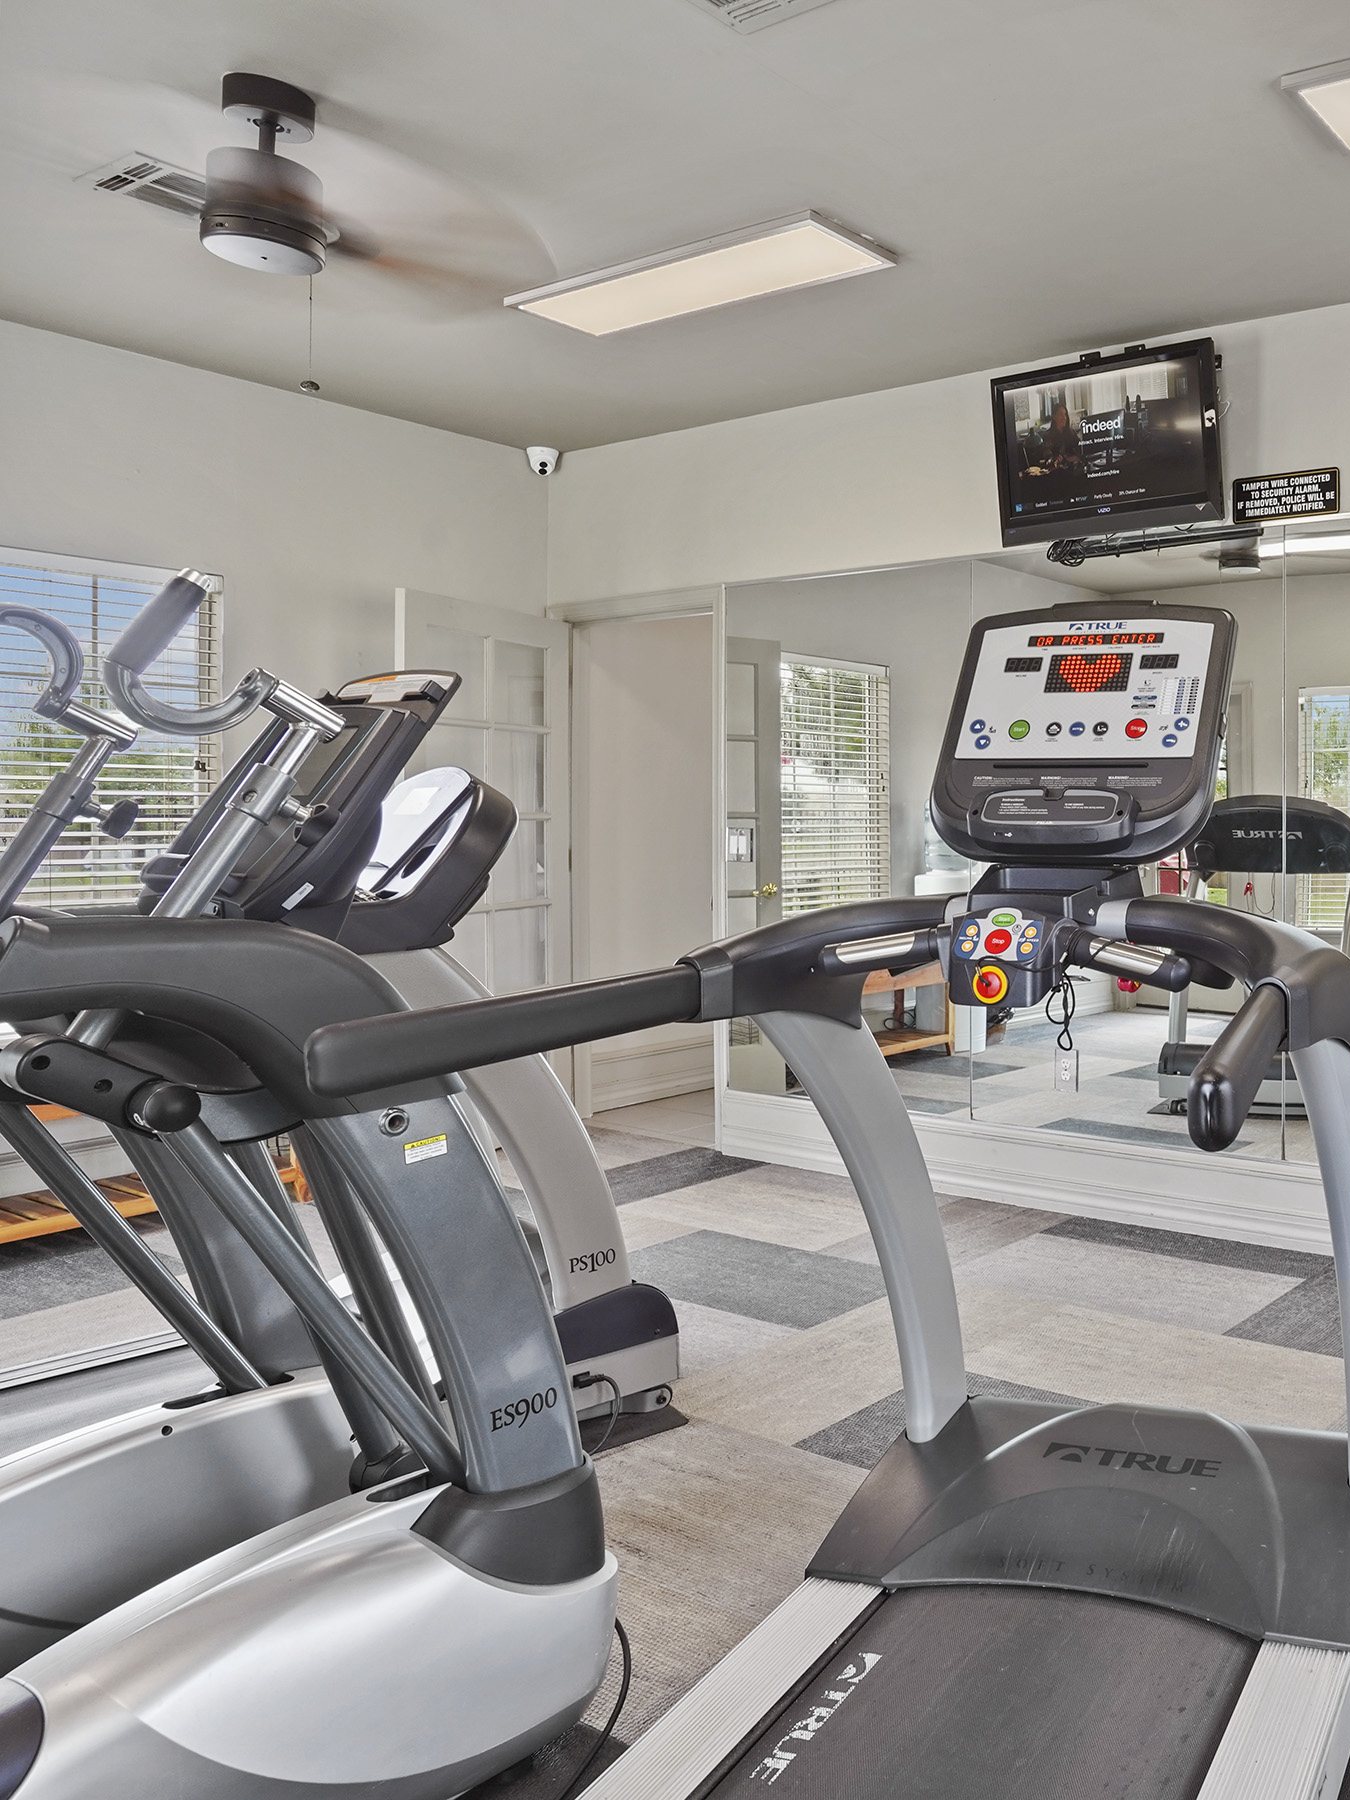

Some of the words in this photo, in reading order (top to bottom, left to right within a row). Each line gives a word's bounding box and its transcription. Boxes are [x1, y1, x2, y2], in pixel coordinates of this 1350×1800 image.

[1081, 416, 1120, 434] indeed
[1242, 481, 1269, 491] TAMPER
[1271, 478, 1288, 488] WIRE
[1290, 474, 1331, 486] CONNECTED
[1251, 491, 1260, 499] TO
[1261, 487, 1294, 498] SECURITY
[1295, 484, 1321, 494] ALARM.
[1237, 502, 1244, 510] IF
[1245, 498, 1280, 509] REMOVED,
[1281, 495, 1306, 504] POLICE
[1307, 493, 1324, 502] WILL
[1325, 491, 1335, 500] BE
[1245, 505, 1292, 517] IMMEDIATELY
[1292, 501, 1326, 512] NOTIFIED.
[1086, 622, 1128, 630] TRUE
[1036, 636, 1054, 648] OR
[1061, 635, 1103, 646] PRESS
[1112, 634, 1156, 645] ENTER
[569, 1248, 616, 1273] PS100
[490, 1387, 557, 1432] ES900
[1094, 1447, 1222, 1478] TRUE
[749, 1685, 856, 1786] TRUE
